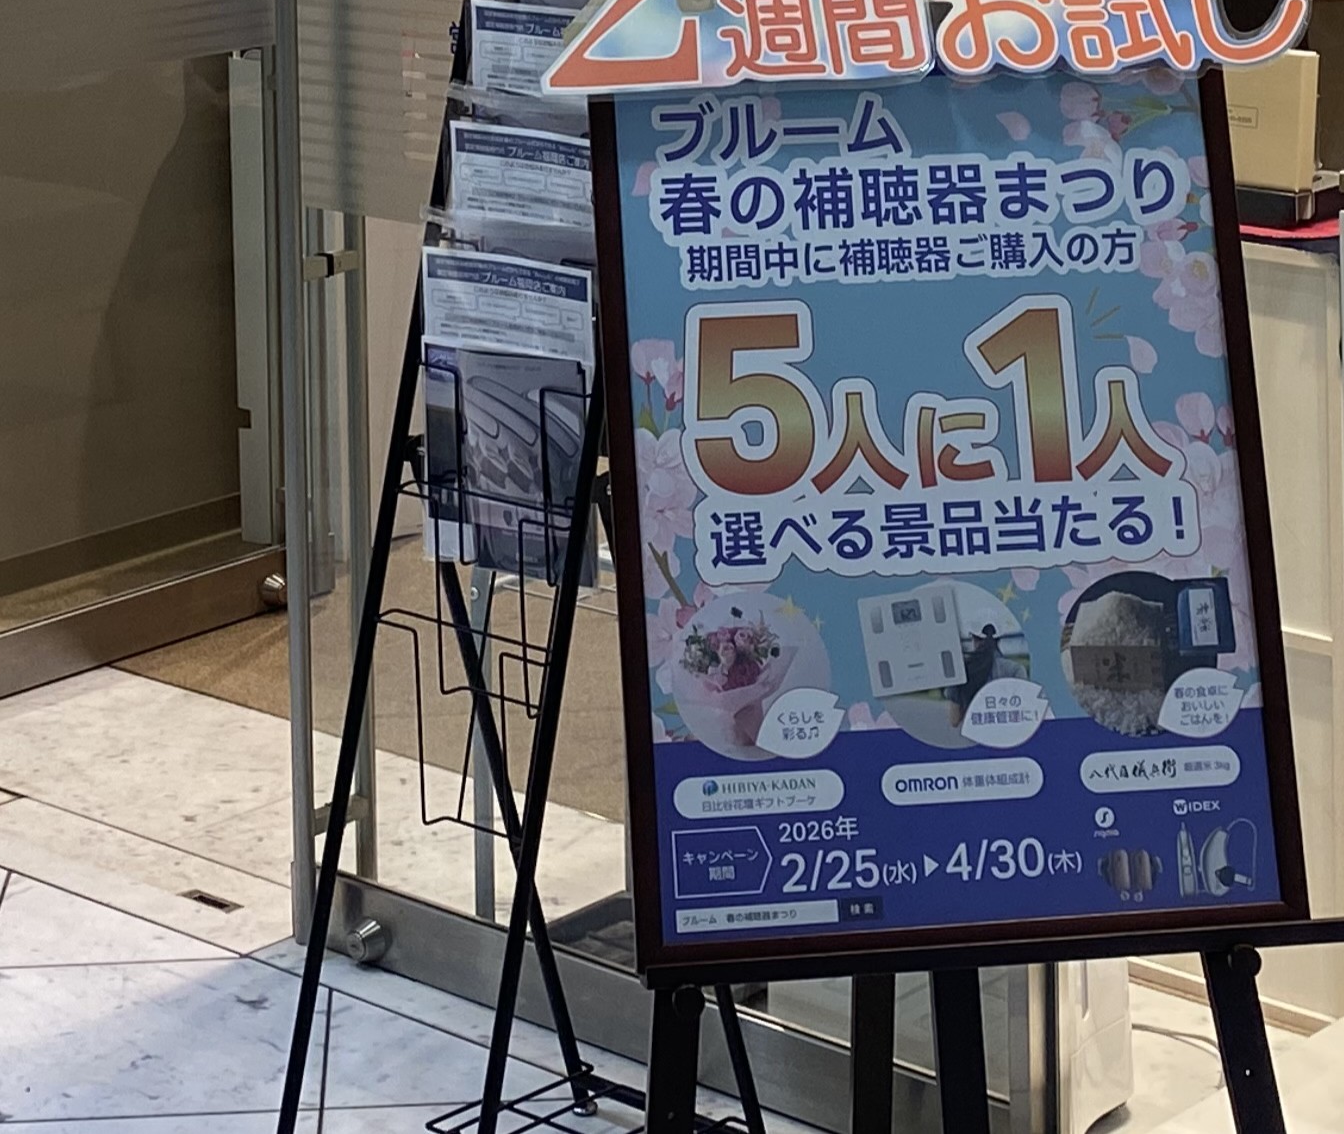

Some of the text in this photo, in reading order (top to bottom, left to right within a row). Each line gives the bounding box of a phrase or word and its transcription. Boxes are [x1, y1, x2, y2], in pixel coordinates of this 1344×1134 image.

[658, 98, 904, 163] ブルーム
[660, 157, 1176, 236] 春の補聴器まつり
[686, 227, 1138, 283] 期間中に補聴器ご購入の方
[693, 307, 1174, 496] 5人に1人
[984, 695, 1022, 708] 日々の
[1180, 699, 1226, 713] おいしい
[776, 711, 825, 725] くらしを
[1172, 799, 1221, 815] WIDEX
[778, 815, 859, 843] 2026年
[682, 849, 760, 865] キャンペーン
[708, 865, 736, 882] 期間
